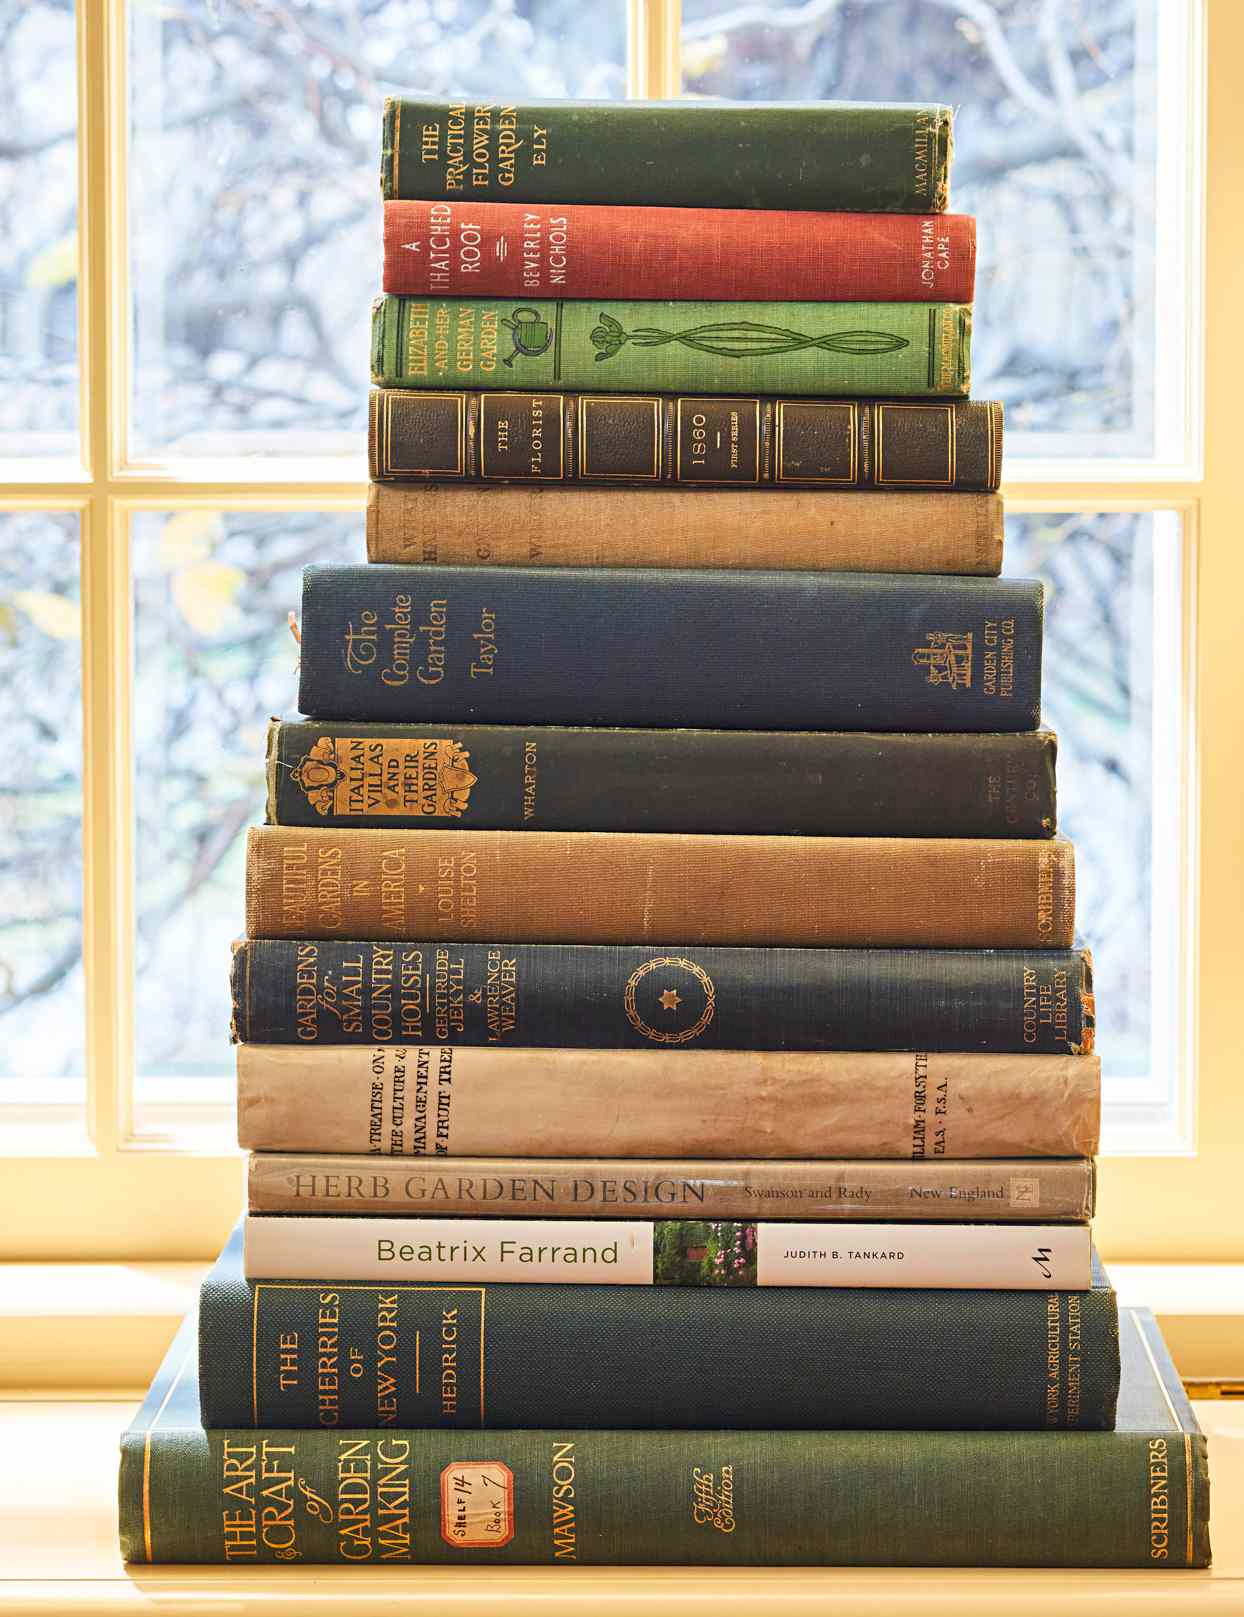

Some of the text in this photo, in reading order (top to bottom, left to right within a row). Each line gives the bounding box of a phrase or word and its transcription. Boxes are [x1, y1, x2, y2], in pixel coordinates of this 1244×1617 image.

[421, 123, 439, 163] THE
[473, 104, 496, 187] FLOWER
[498, 104, 524, 186] GARDEN
[533, 125, 548, 166] ELY
[914, 110, 929, 196] MACMILLAN
[402, 241, 420, 251] A
[430, 205, 452, 290] THATCHED
[460, 223, 481, 272] ROOF
[524, 213, 540, 287] BEVERLEY
[550, 217, 567, 284] NICHOLS
[921, 220, 935, 288] JONATHAN
[937, 236, 949, 270] CAPE
[408, 304, 429, 376] ELIZABETH
[434, 339, 449, 369] AND
[457, 307, 475, 372] GERMAN
[480, 311, 498, 372] GARDEN
[497, 420, 509, 451] THE
[532, 398, 543, 474] FLORIST
[693, 414, 706, 465] 1860
[344, 609, 378, 673] The
[381, 594, 416, 686] Complete
[417, 599, 448, 685] Garden
[470, 607, 498, 679] Taylor
[984, 620, 998, 695] GARDEN CITY
[1000, 639, 1015, 697] PUBLISHING
[350, 740, 366, 815] ITALIAN
[368, 743, 384, 809] VILLAS
[387, 758, 400, 794] AND
[404, 751, 420, 808] THEIR
[421, 741, 438, 815] GARDENS
[524, 742, 537, 821] WHARTON
[318, 847, 342, 929] GARDENS
[353, 880, 370, 897] IN
[382, 848, 406, 931] AMERICA
[438, 856, 455, 922] LOUISE
[461, 850, 478, 929] SHELTON
[297, 945, 319, 1041] GARDENS
[317, 975, 343, 1021] for
[343, 953, 363, 1033] SMALL
[372, 946, 394, 1041] COUNTRY
[401, 950, 423, 1038] HOUSES
[436, 949, 449, 1039] GERTRUDE
[450, 958, 464, 1032] JEKYLL
[469, 990, 482, 1004] &
[488, 950, 501, 1042] LAWRENCE
[502, 958, 517, 1032] WEAVER
[1023, 965, 1037, 1043] COUNTRY
[1040, 984, 1052, 1025] LIFE
[1055, 967, 1067, 1041] LIBRARY
[370, 1082, 384, 1144] TREATISE
[392, 1065, 406, 1126] CULTURE
[436, 1090, 451, 1140] FRUIT
[936, 1077, 948, 1115] F.S.A.
[391, 1129, 403, 1154] THE
[293, 1174, 391, 1199] HERB
[404, 1175, 557, 1202] GARDEN
[572, 1179, 707, 1204] DESIGN
[744, 1185, 803, 1200] Swanson
[808, 1185, 833, 1200] and
[838, 1186, 872, 1204] Rady
[910, 1186, 942, 1200] New
[950, 1186, 1005, 1204] England
[377, 1239, 905, 1265] Beatrix Farrand JUDITH B. TANKARD
[1068, 1296, 1081, 1350] STATION
[280, 1331, 299, 1392] THE
[319, 1292, 340, 1425] CHERRIES
[350, 1347, 364, 1378] OF
[442, 1308, 458, 1415] HEDRICK
[223, 1439, 257, 1560] THE ART
[260, 1439, 297, 1548] CRAFT
[298, 1478, 333, 1524] of
[338, 1440, 373, 1560] GARDEN
[377, 1439, 411, 1560] MAKING
[453, 1474, 472, 1537] SHELF 14
[481, 1474, 508, 1490] 7
[553, 1442, 576, 1560] MAWSON
[693, 1467, 716, 1524] Fifth
[713, 1464, 736, 1533] Edition
[1149, 1438, 1168, 1559] SCRIBNERS
